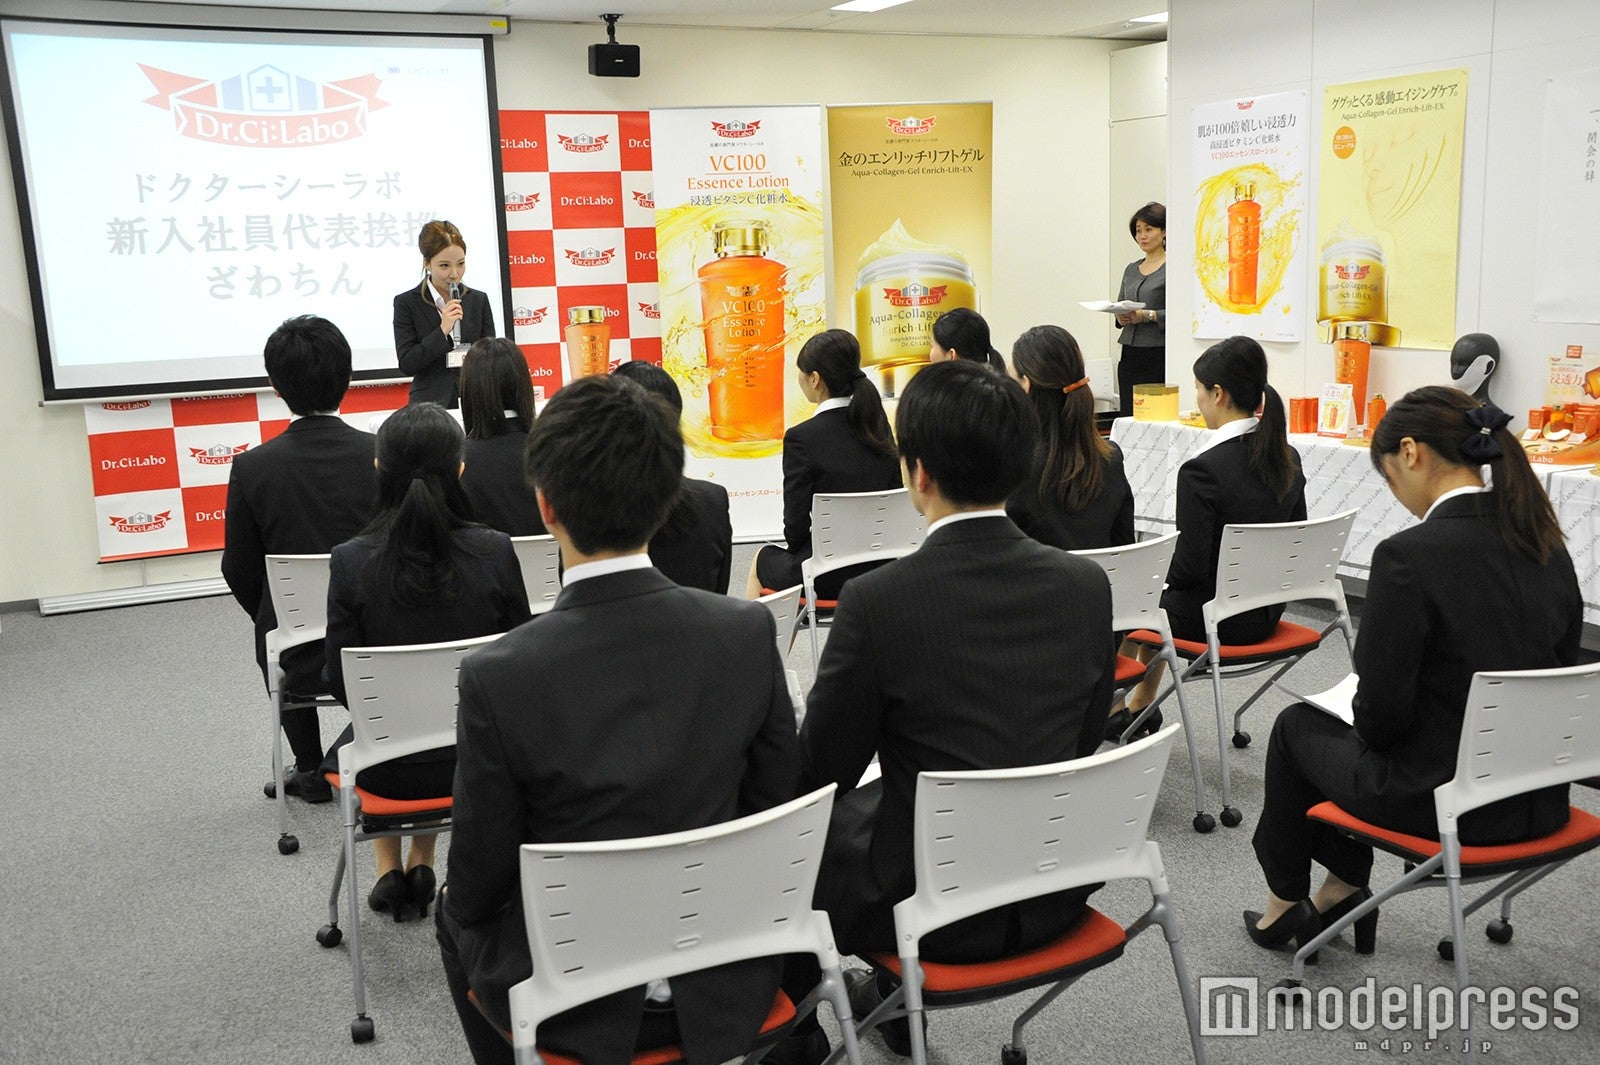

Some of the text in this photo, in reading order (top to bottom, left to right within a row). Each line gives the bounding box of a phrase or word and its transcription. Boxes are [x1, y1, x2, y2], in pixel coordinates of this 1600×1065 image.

[194, 112, 350, 144] Dr.Ci:Labo
[500, 138, 538, 149] Ci:Labo
[566, 144, 601, 152] Dr.Ci:Labo
[709, 153, 767, 172] VC100
[838, 148, 985, 167] 金のエンリッチリフトゲル
[851, 166, 973, 178] Aqua-Collagen-Gel Enrich-Lift-EX
[134, 171, 404, 203] ドクターシーラボ
[687, 175, 789, 190] Essence Lotion
[560, 196, 614, 206] Dr.Ci:Labo
[690, 193, 789, 206] 浸透ビタミンC化粧水
[506, 203, 532, 211] Ci:Labo
[508, 254, 546, 265] Ci:Labo
[574, 258, 609, 266] Dr.Ci:Labo
[206, 262, 364, 300] ざわちん
[722, 299, 766, 313] VC100
[723, 317, 765, 328] Essence
[729, 328, 761, 338] Lotion
[106, 401, 147, 411] Dr.Ci:Labo
[101, 455, 167, 470] Dr.Ci:Labo
[121, 523, 162, 533] Dr.Ci:Labo
